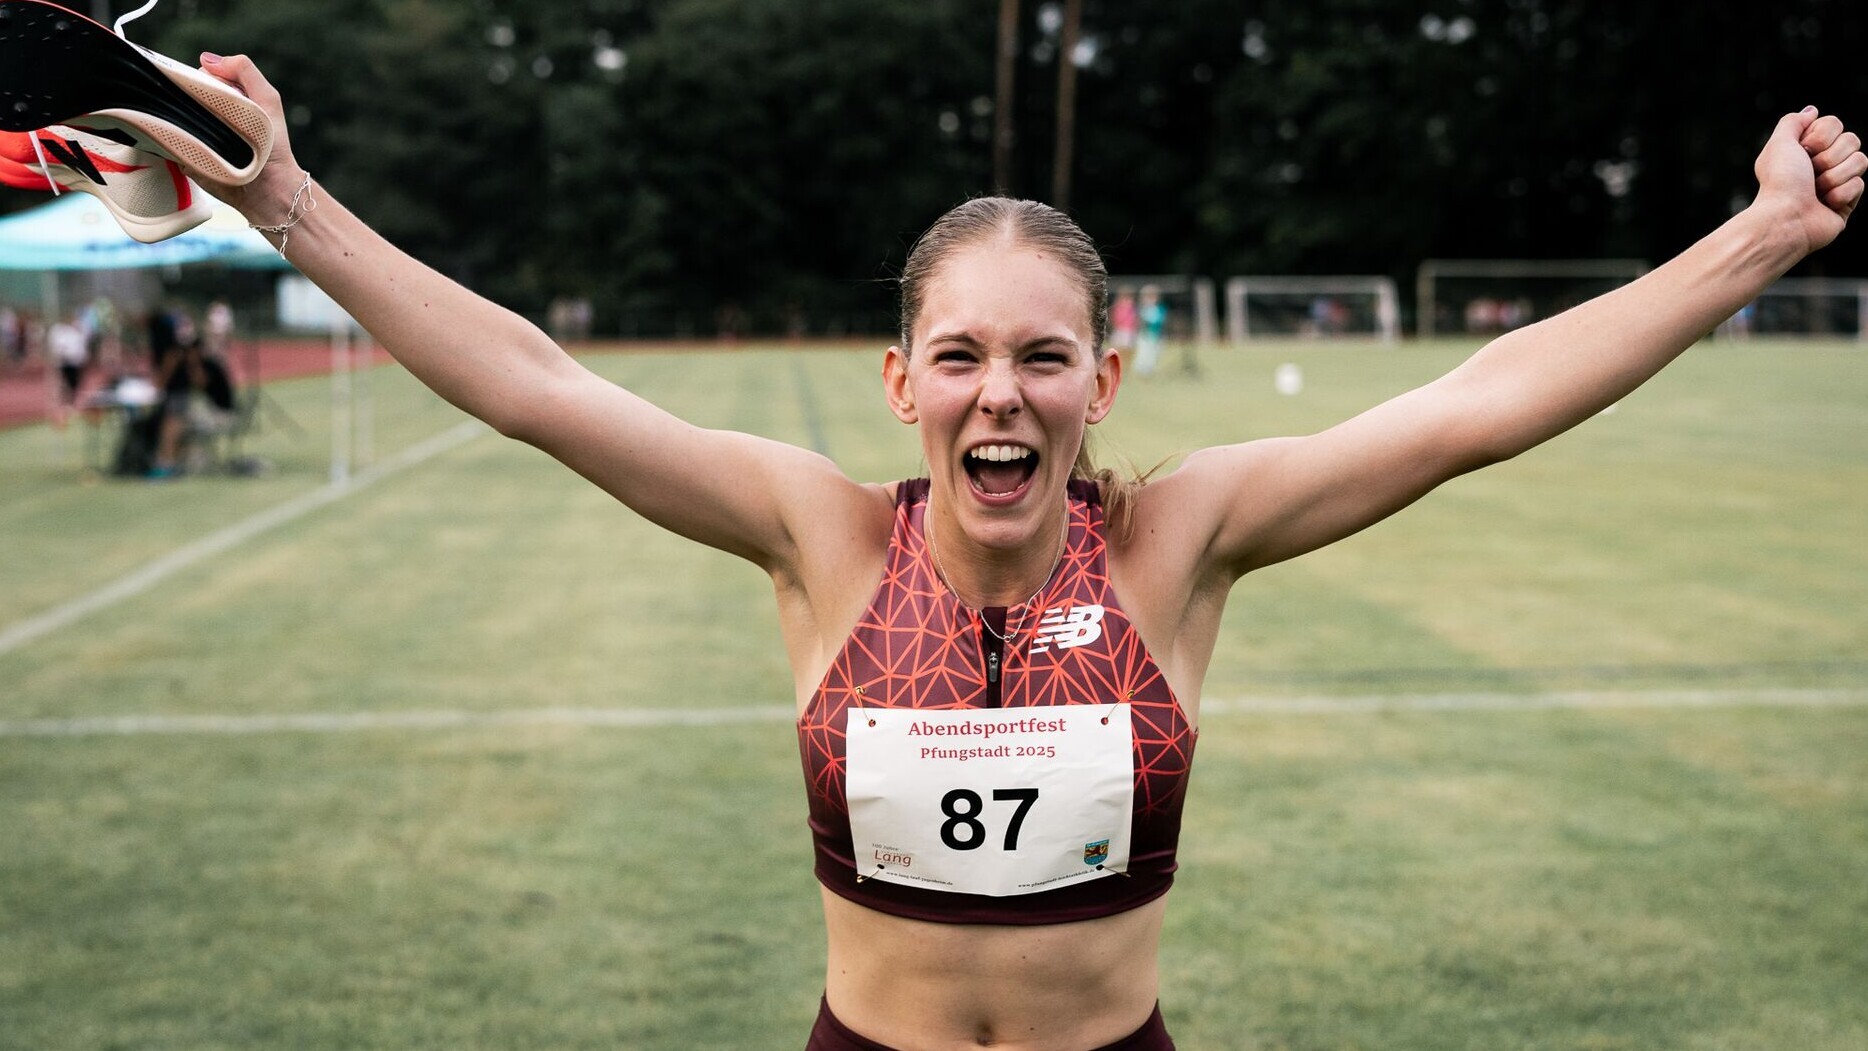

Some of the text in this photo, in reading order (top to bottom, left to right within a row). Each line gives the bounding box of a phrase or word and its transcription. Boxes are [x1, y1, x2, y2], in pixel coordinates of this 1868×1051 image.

[907, 717, 1067, 739] Abendsportfest
[920, 745, 1056, 761] Pfungstadt 2025
[940, 788, 1039, 851] 87
[874, 849, 912, 868] Lang
